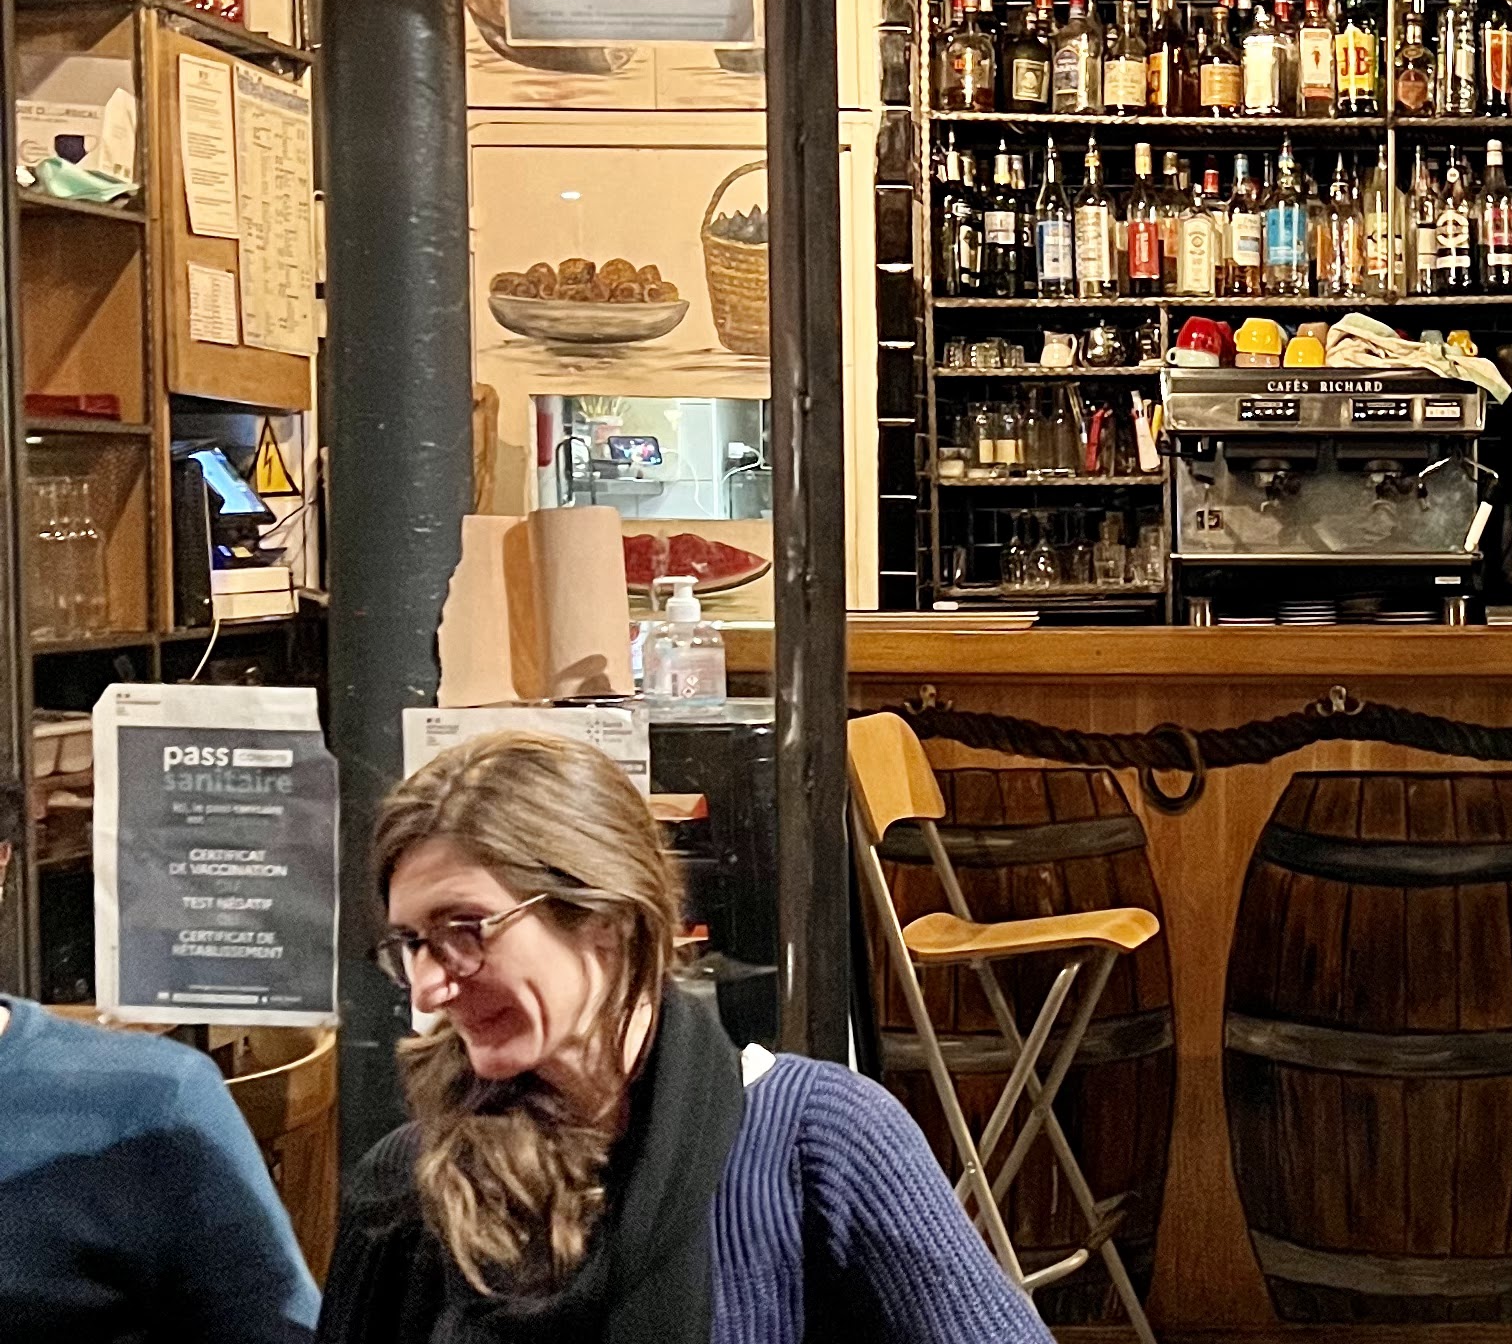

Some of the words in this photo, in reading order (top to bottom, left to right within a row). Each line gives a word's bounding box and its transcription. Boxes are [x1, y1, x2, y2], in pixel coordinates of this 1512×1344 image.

[1320, 381, 1383, 392] RICHARD
[164, 746, 229, 772] pass
[163, 767, 293, 793] sanitaire
